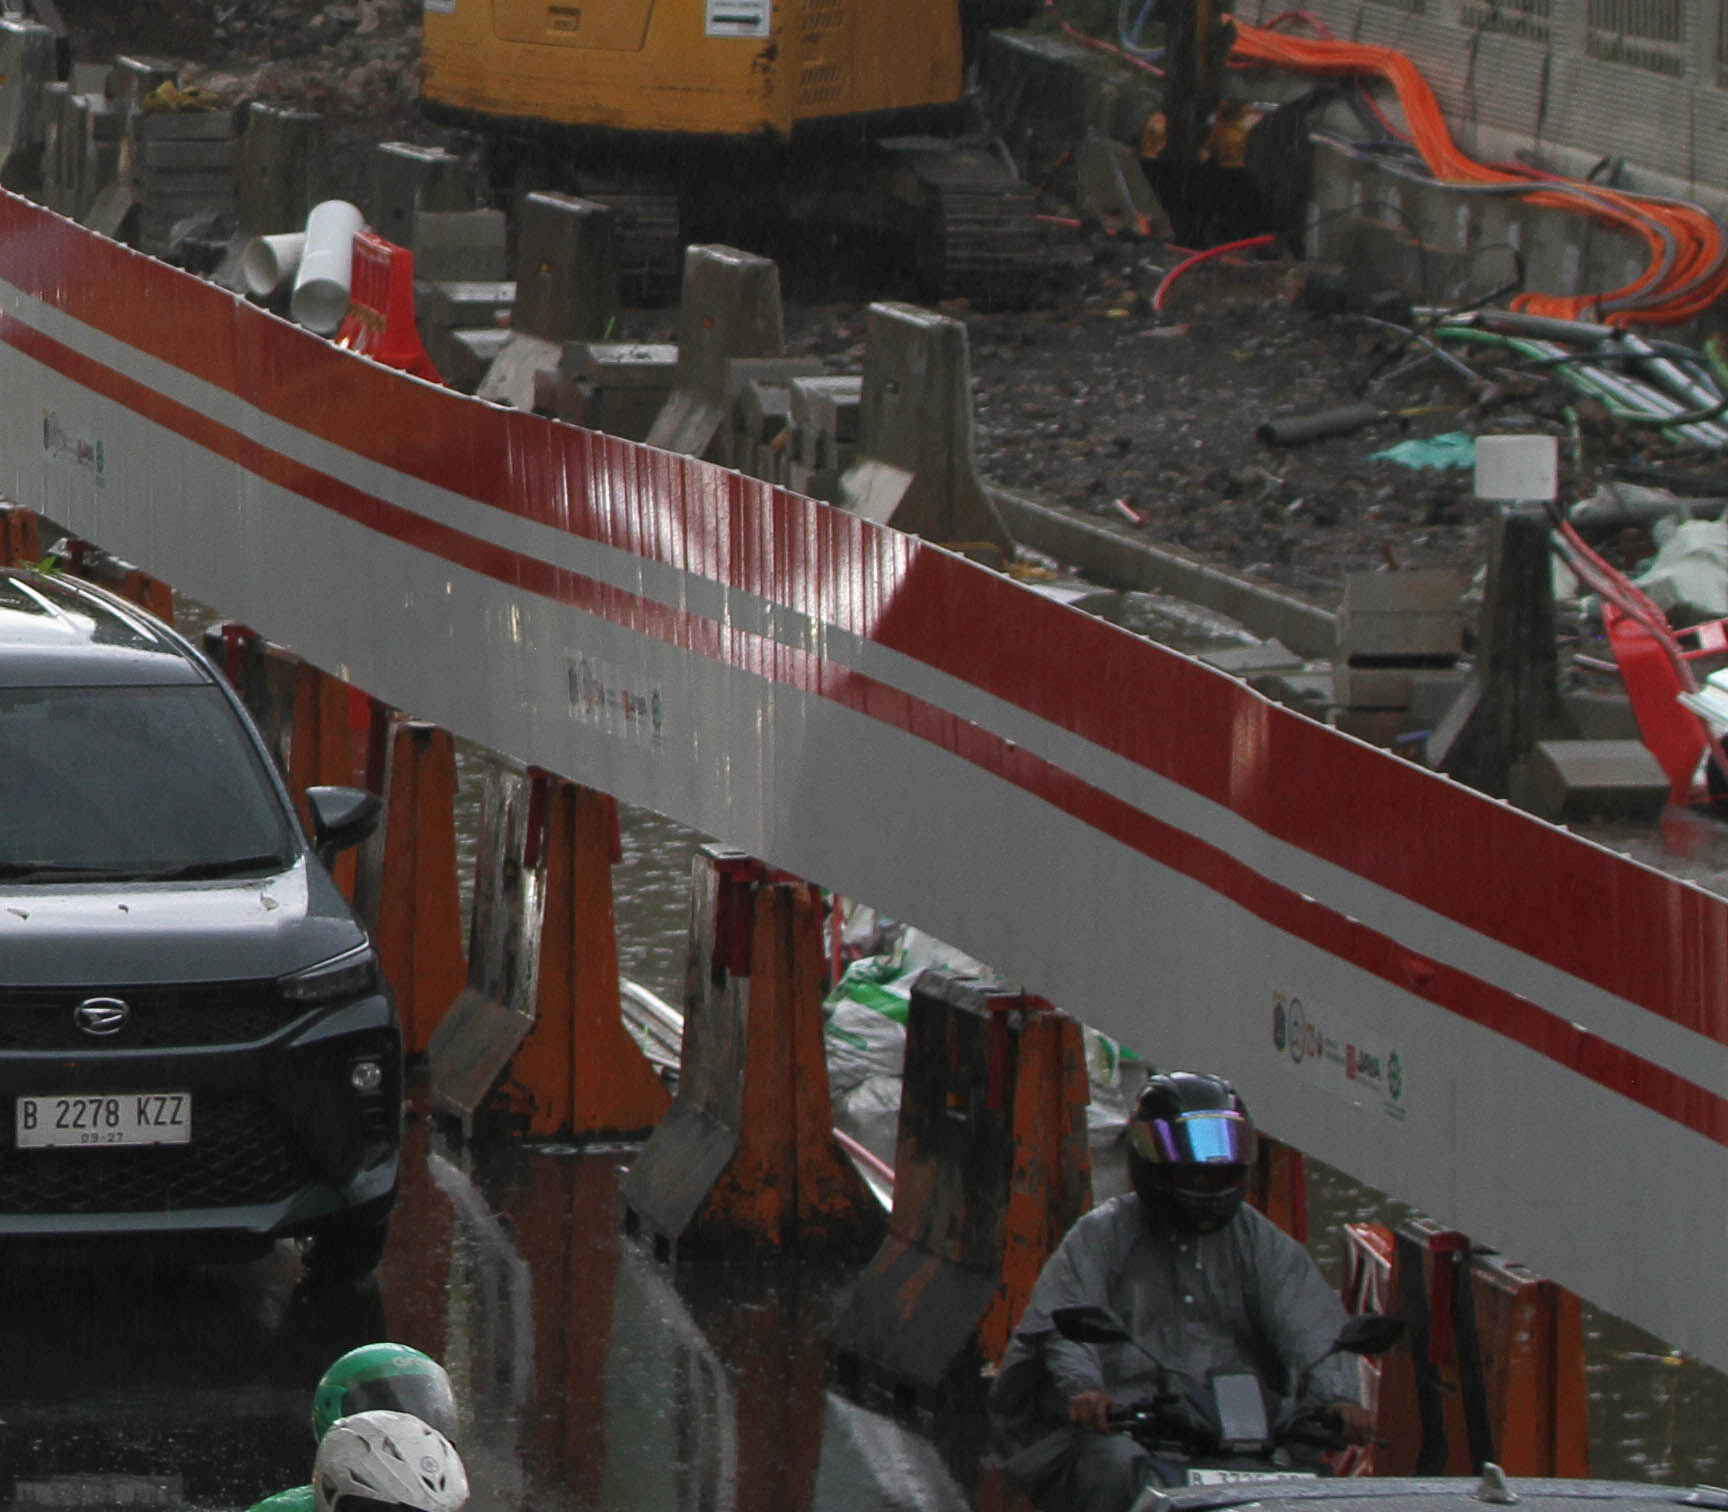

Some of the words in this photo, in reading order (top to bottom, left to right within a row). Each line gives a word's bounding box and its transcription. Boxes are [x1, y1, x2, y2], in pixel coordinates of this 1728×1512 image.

[23, 1100, 38, 1130] B
[55, 1098, 120, 1129] 2278
[136, 1095, 184, 1126] KZZ
